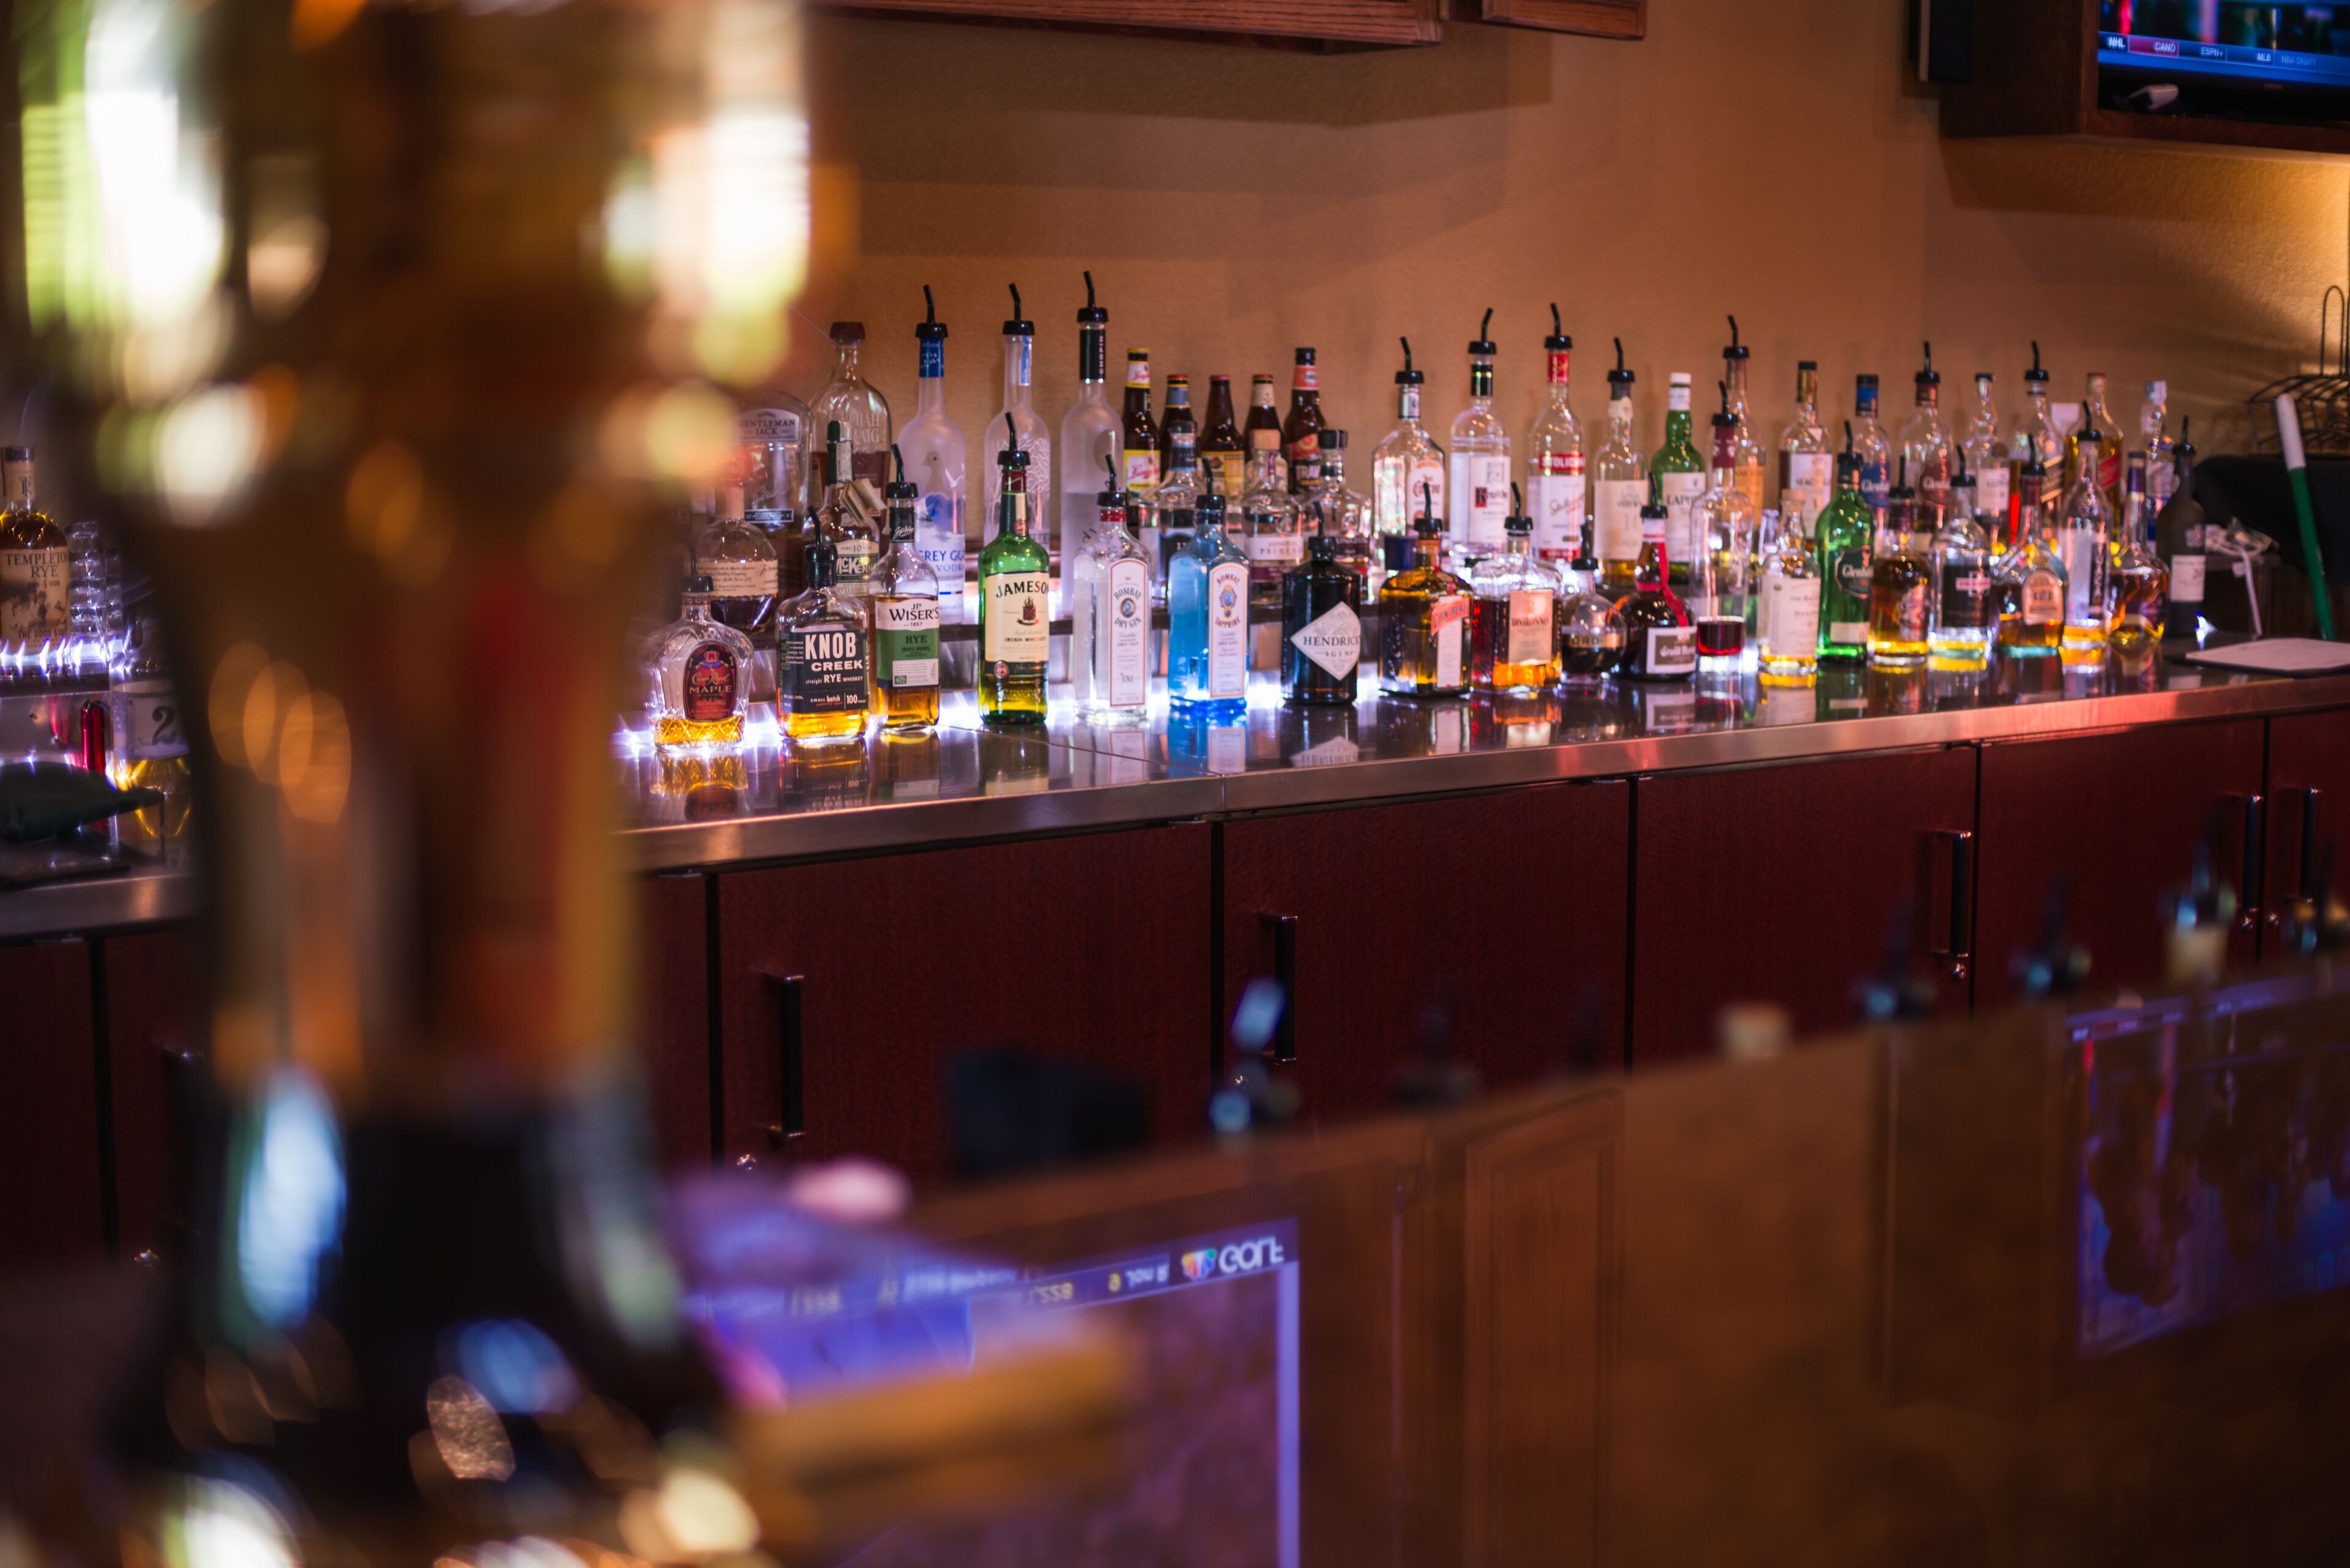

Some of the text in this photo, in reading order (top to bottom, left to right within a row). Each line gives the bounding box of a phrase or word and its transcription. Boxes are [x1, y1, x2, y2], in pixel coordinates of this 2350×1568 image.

[2108, 37, 2125, 49] NHL
[2201, 47, 2225, 58] ESPN+
[2257, 53, 2272, 62] MLB
[755, 428, 778, 437] JACK
[31, 565, 58, 578] RYE
[1216, 573, 1240, 587] BOMBAY
[996, 581, 1049, 598] JAMESO
[1114, 587, 1141, 601] BOMBAY
[889, 607, 939, 621] WISER'S
[1114, 616, 1142, 629] DRY GIN
[1215, 615, 1240, 628] SAPPHIRE
[906, 635, 927, 644] RYE
[805, 632, 856, 660] KNOB
[811, 660, 864, 672] CREEK
[824, 674, 841, 684] RYE
[690, 685, 733, 694] MAPLE
[826, 694, 841, 703] batch
[846, 694, 857, 704] 100
[151, 706, 176, 745] 2
